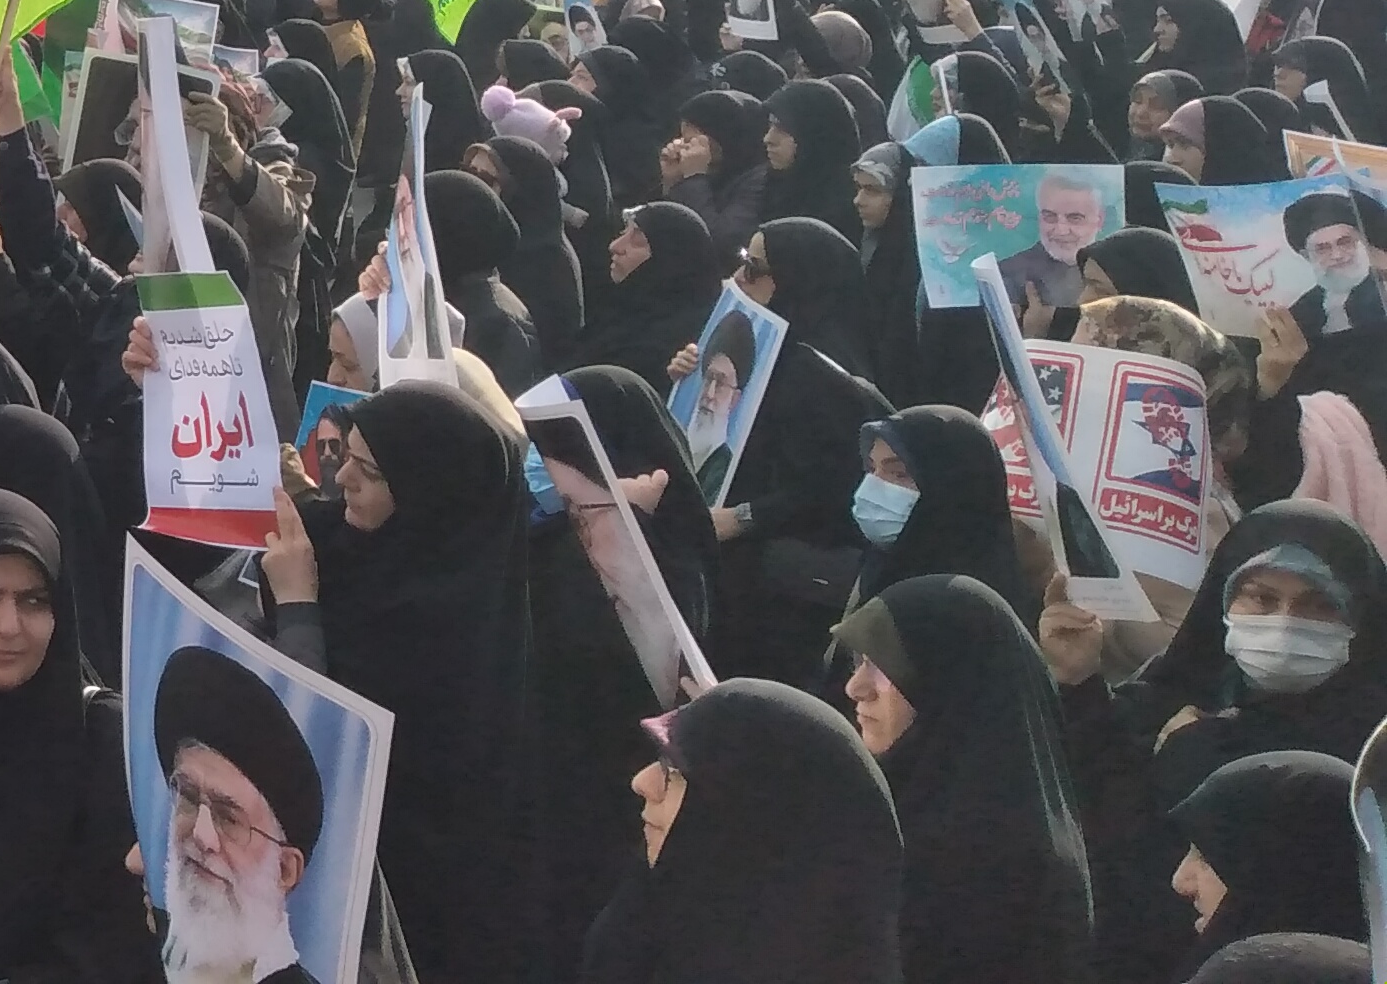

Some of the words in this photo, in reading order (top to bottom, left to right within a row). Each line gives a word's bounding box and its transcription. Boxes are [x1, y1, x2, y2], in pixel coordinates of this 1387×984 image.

[171, 390, 254, 462] ایران
[170, 468, 259, 495] شویم
[1100, 493, 1163, 523] اسرائیل
